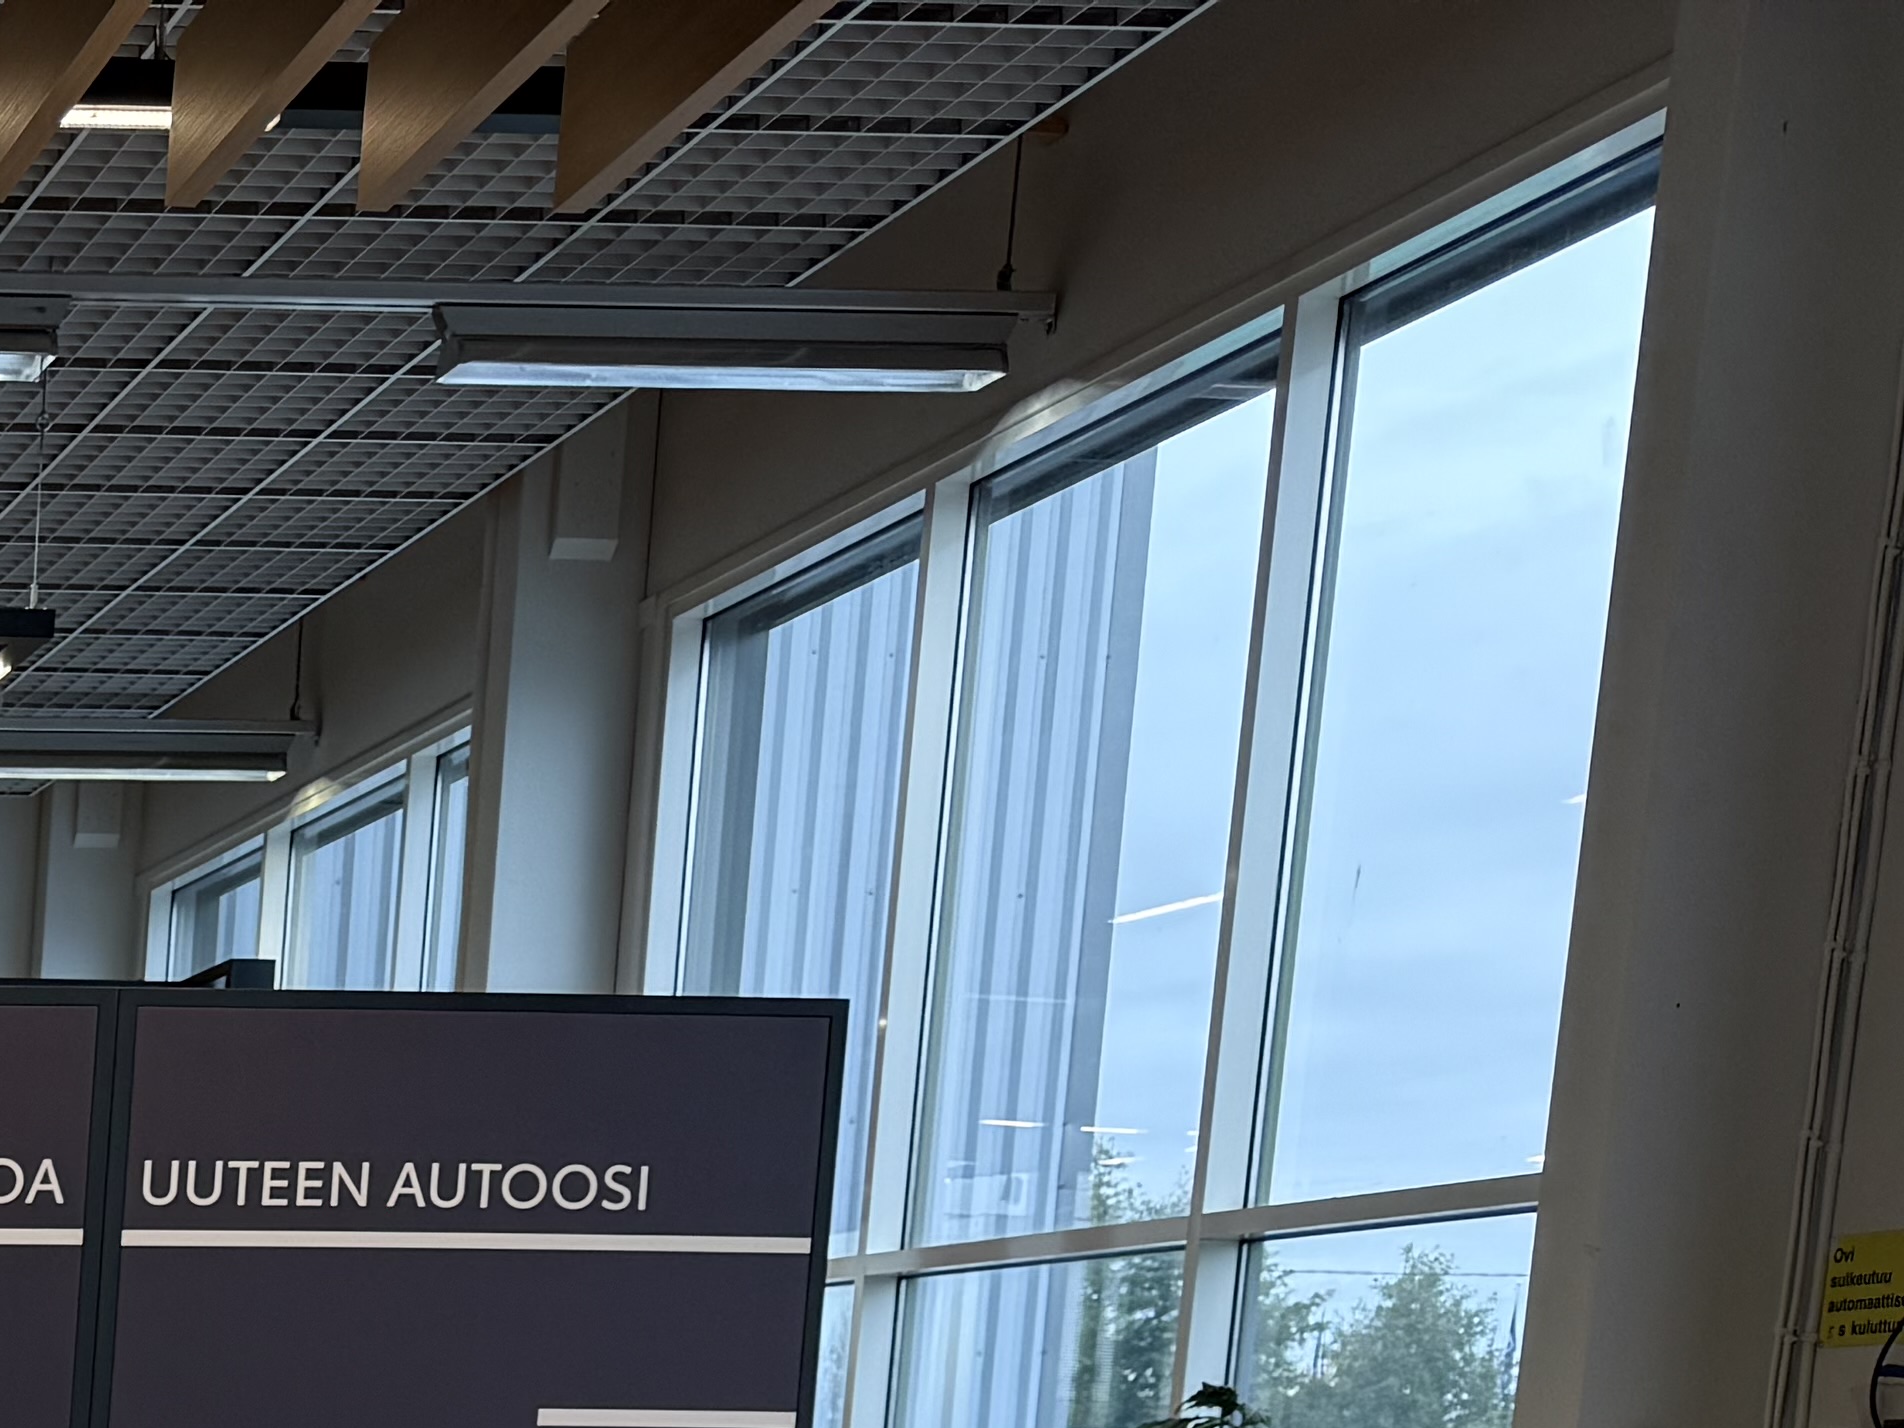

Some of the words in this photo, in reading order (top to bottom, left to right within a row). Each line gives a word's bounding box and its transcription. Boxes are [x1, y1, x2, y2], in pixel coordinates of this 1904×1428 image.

[142, 1160, 369, 1209] UUTEEN
[387, 1163, 650, 1212] AUTOOSI
[1834, 1246, 1856, 1263] Ovi
[1851, 1318, 1900, 1336] kuluttu
